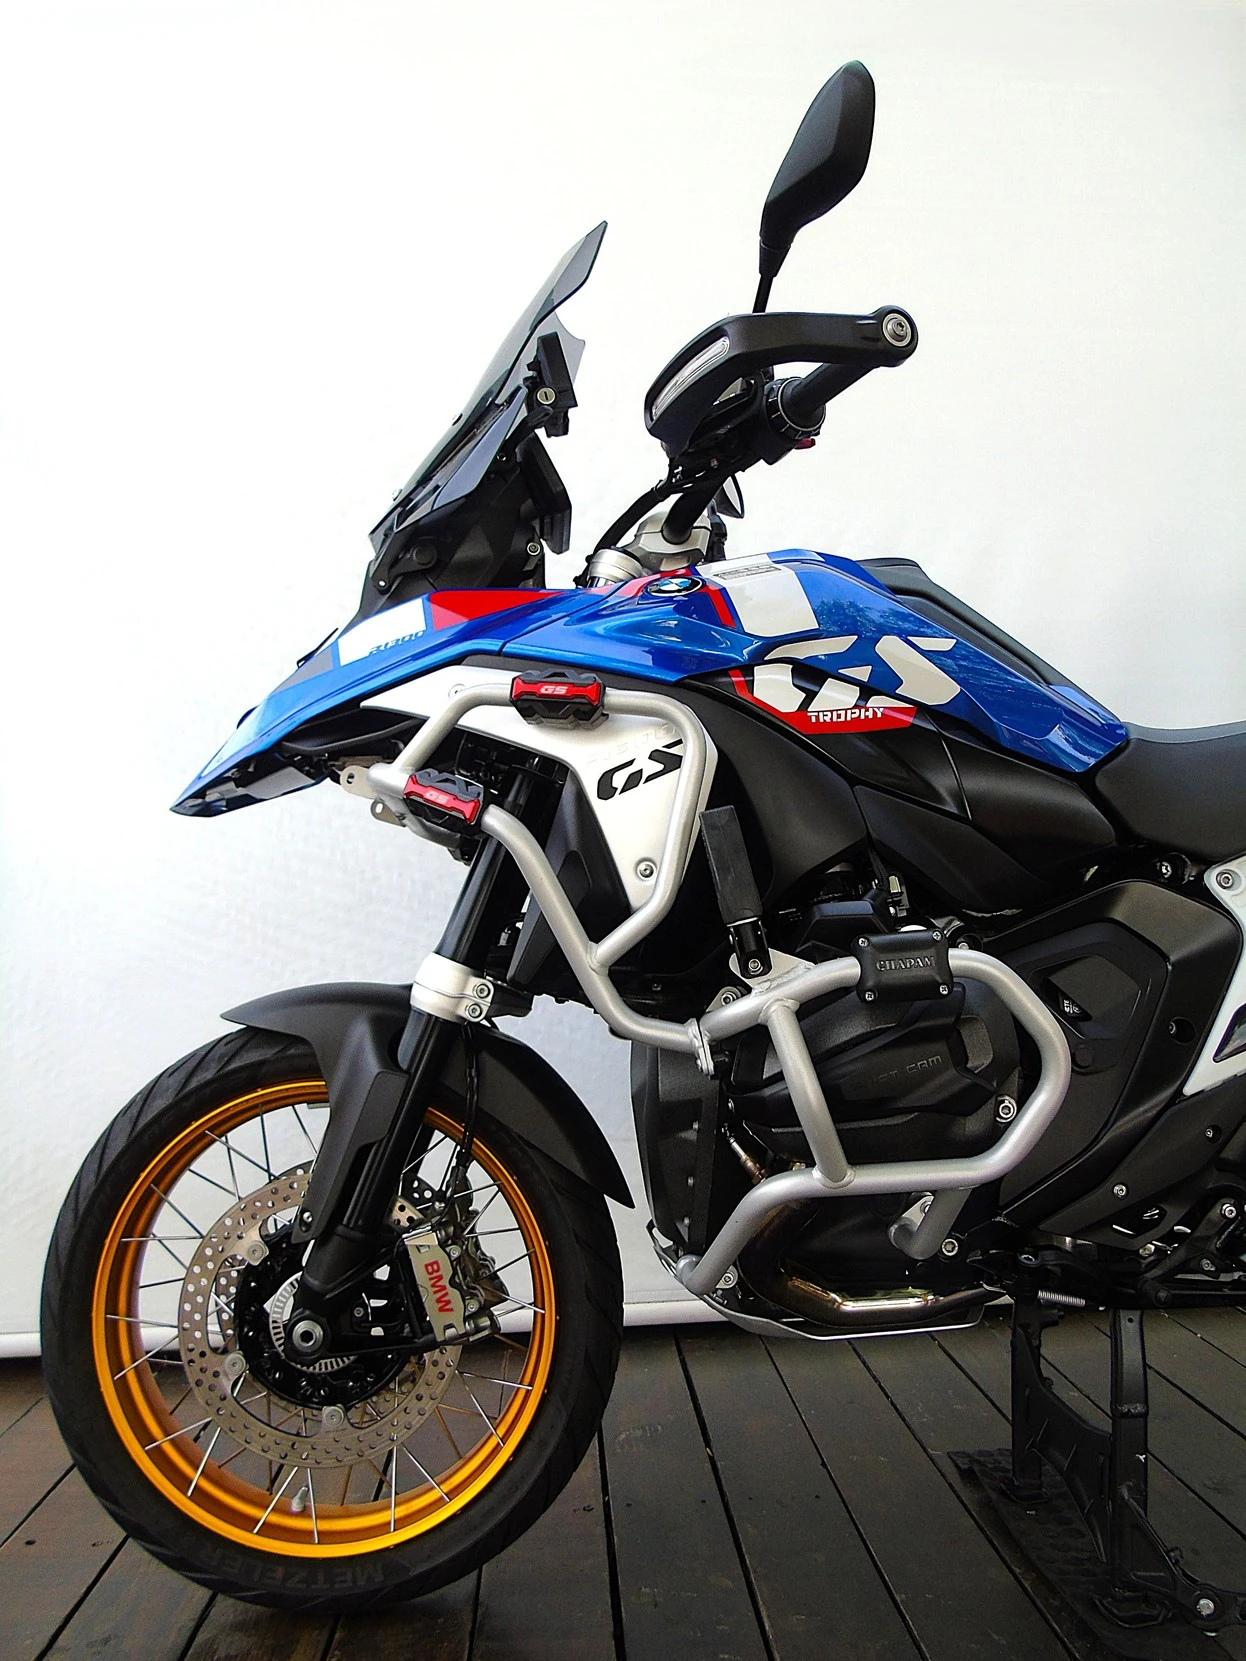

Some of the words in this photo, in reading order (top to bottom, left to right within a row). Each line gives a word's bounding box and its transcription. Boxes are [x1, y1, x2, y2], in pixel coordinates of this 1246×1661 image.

[540, 685, 568, 695] GS
[807, 707, 885, 723] TROPHY
[597, 738, 684, 801] GS
[876, 956, 936, 971] CHAPAM
[424, 1260, 454, 1313] BMW
